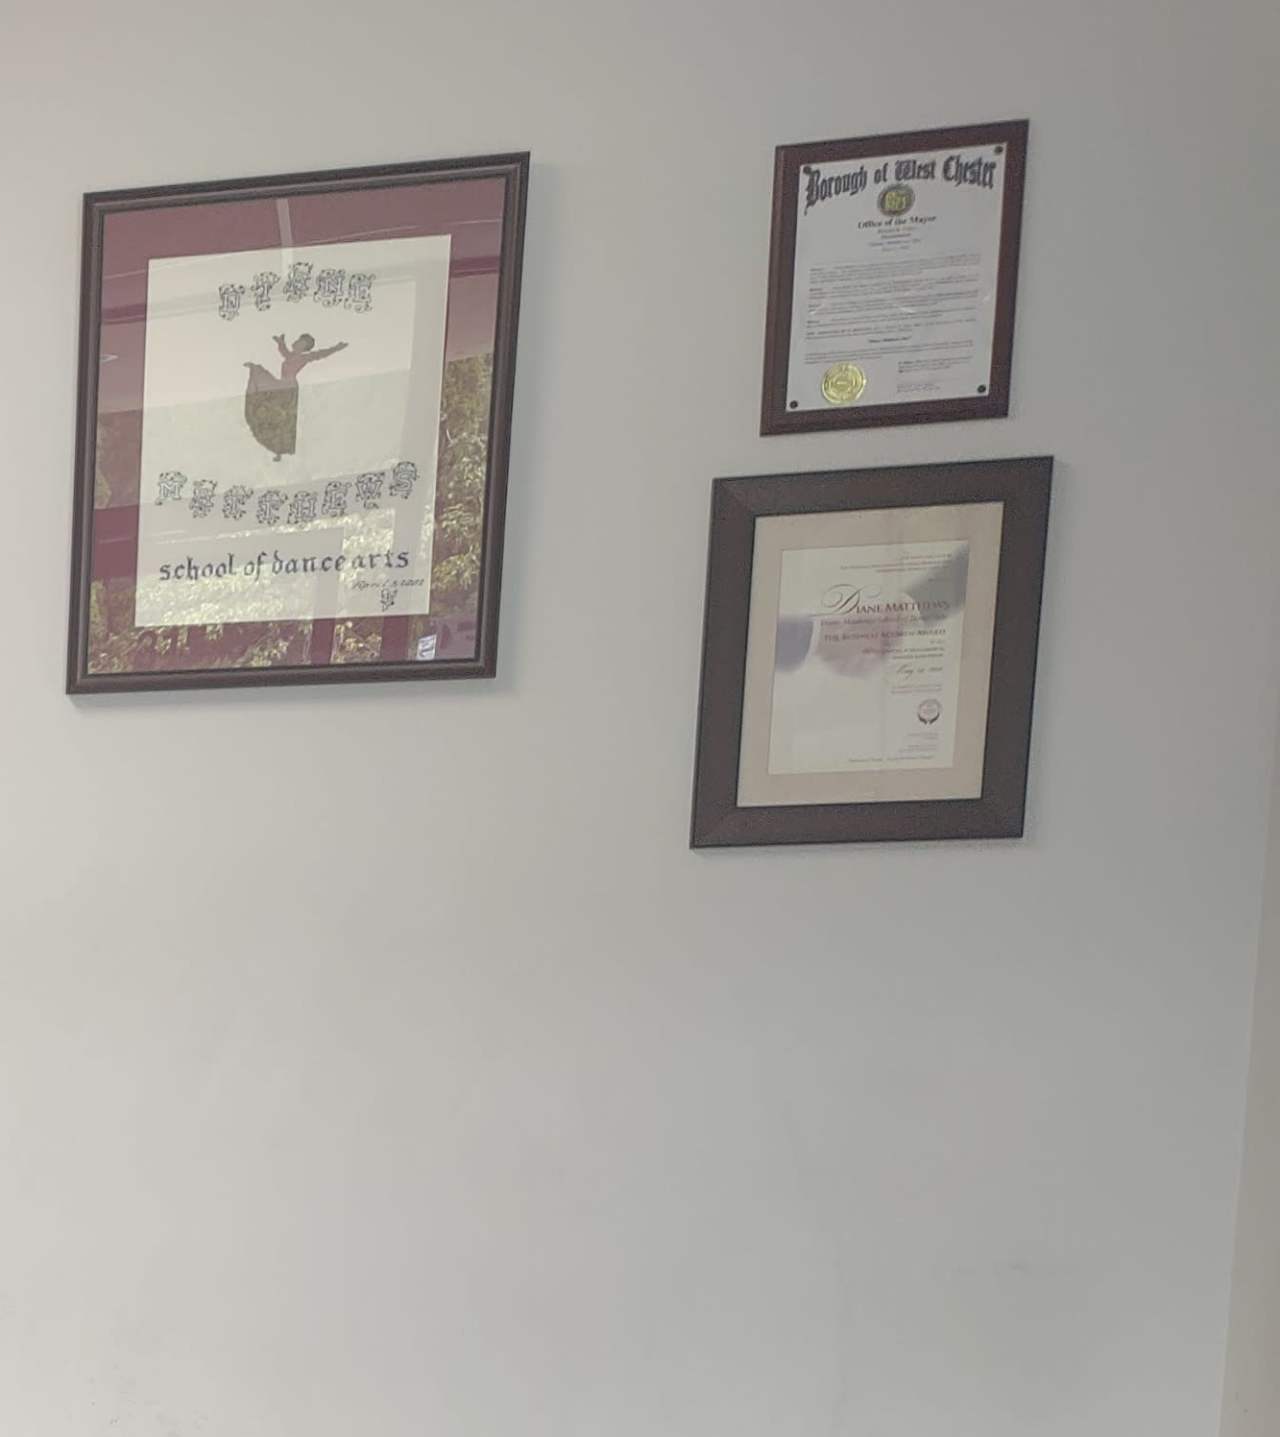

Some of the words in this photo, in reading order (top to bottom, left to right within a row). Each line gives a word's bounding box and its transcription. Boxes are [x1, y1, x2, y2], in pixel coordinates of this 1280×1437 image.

[803, 165, 868, 216] Borough
[874, 162, 888, 183] of
[895, 158, 936, 181] West
[942, 155, 996, 189] Chester
[217, 262, 376, 321] DIANE
[155, 460, 420, 527] MATTHEWS
[158, 553, 238, 581] school
[243, 550, 269, 581] of
[271, 550, 346, 575] dance
[351, 549, 410, 570] arts
